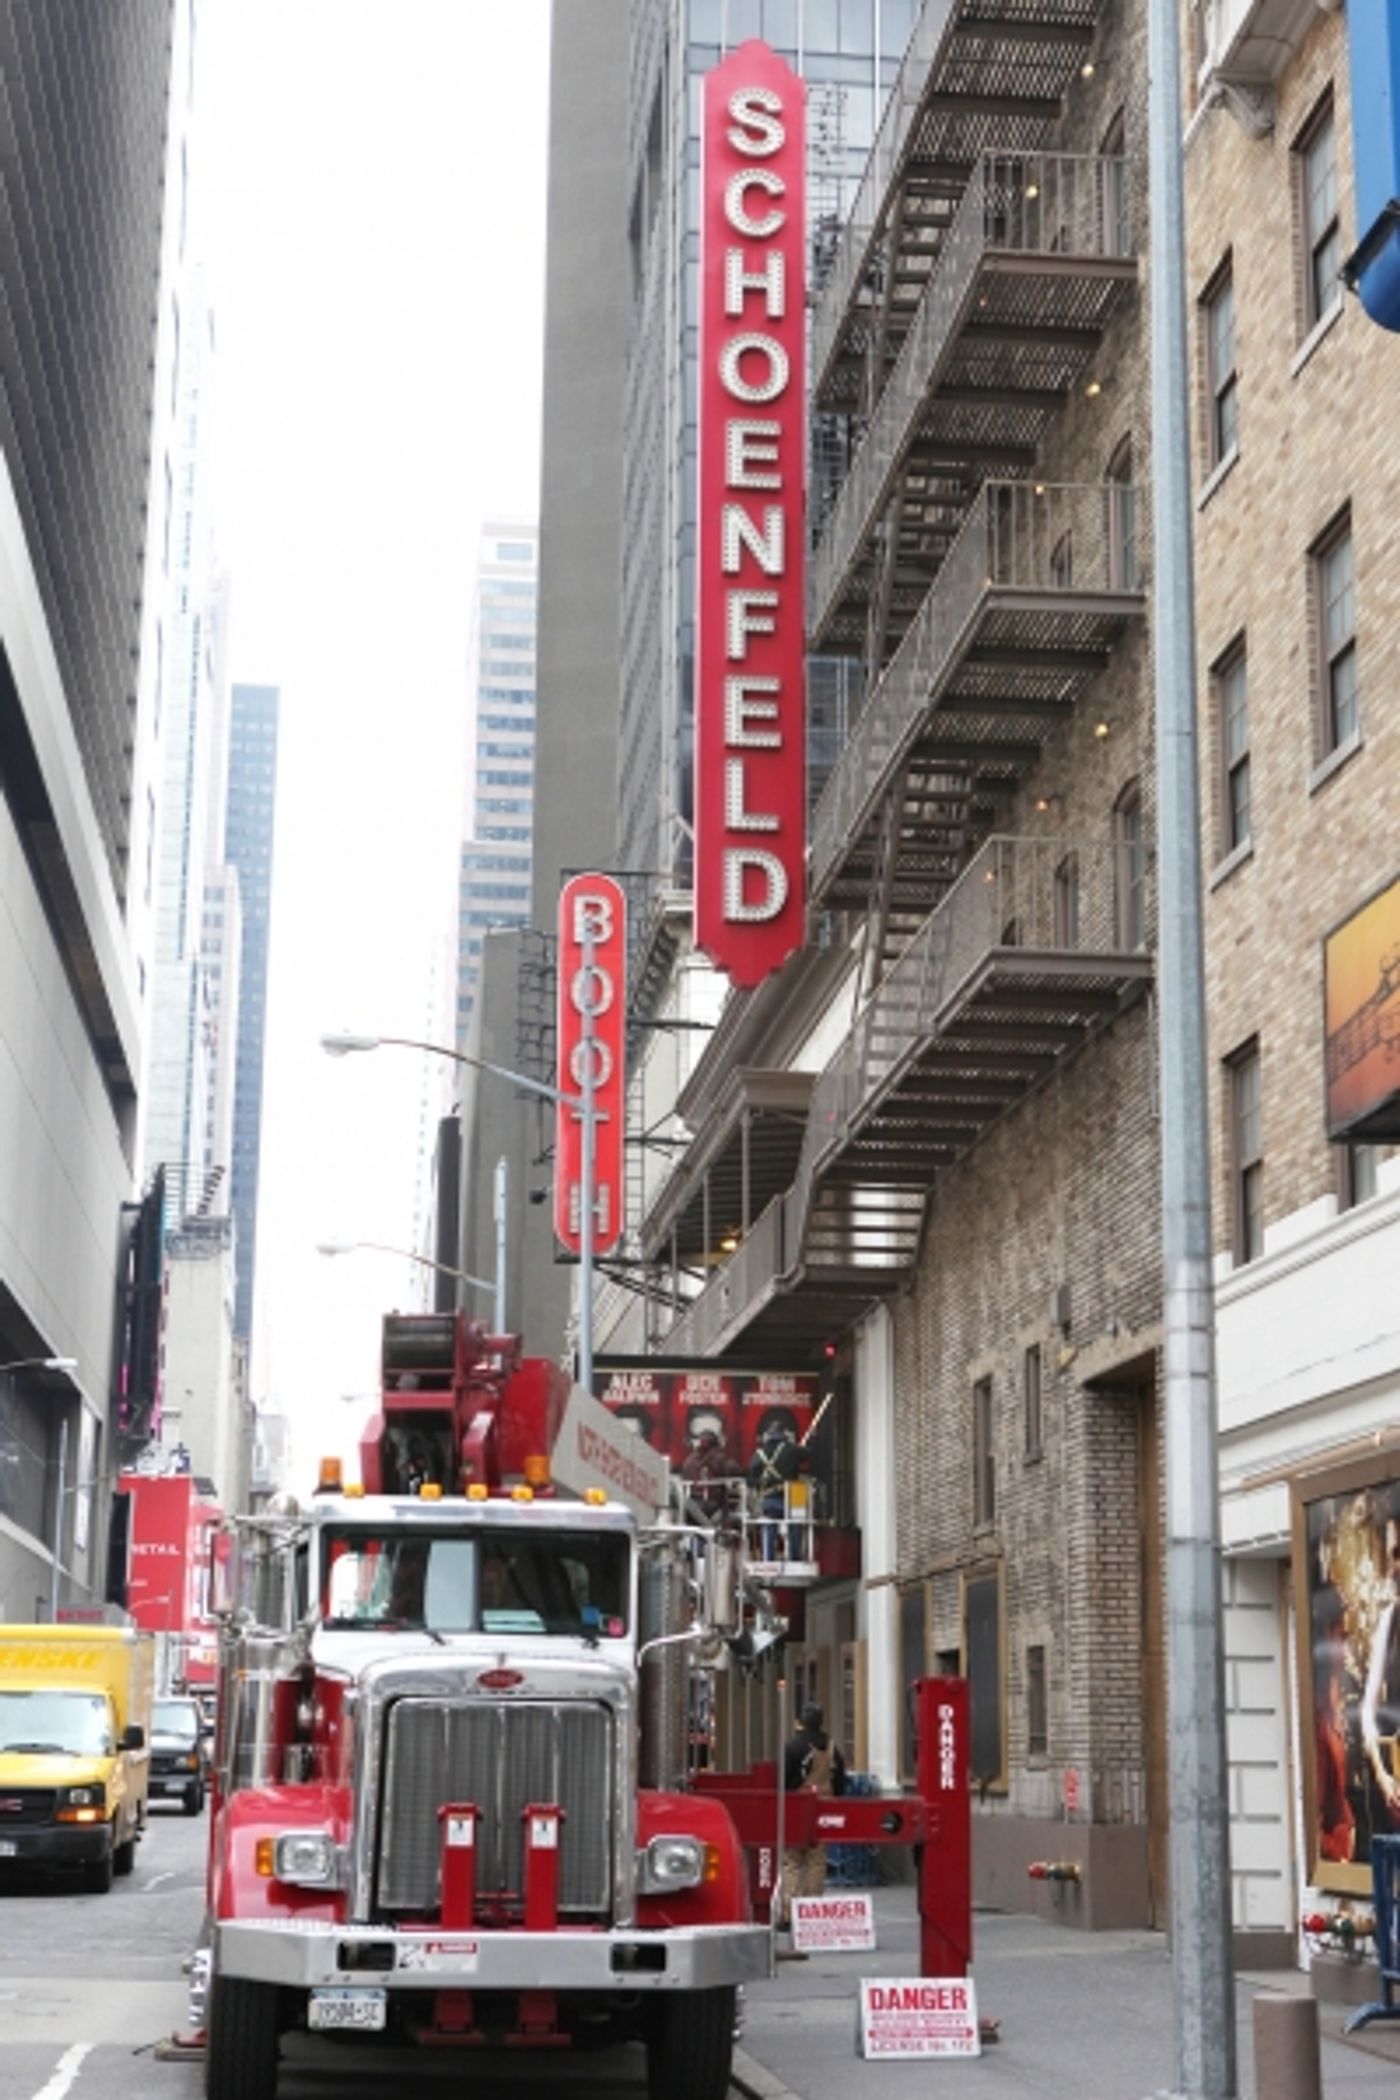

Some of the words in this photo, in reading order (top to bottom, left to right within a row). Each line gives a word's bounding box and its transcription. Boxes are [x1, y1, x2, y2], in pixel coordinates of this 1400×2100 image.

[717, 85, 791, 924] SCHOENFELD
[609, 1373, 652, 1391] ALEC
[938, 1704, 956, 1791] DANGER
[796, 1900, 867, 1920] DANGER
[868, 1986, 968, 2011] DANGER
